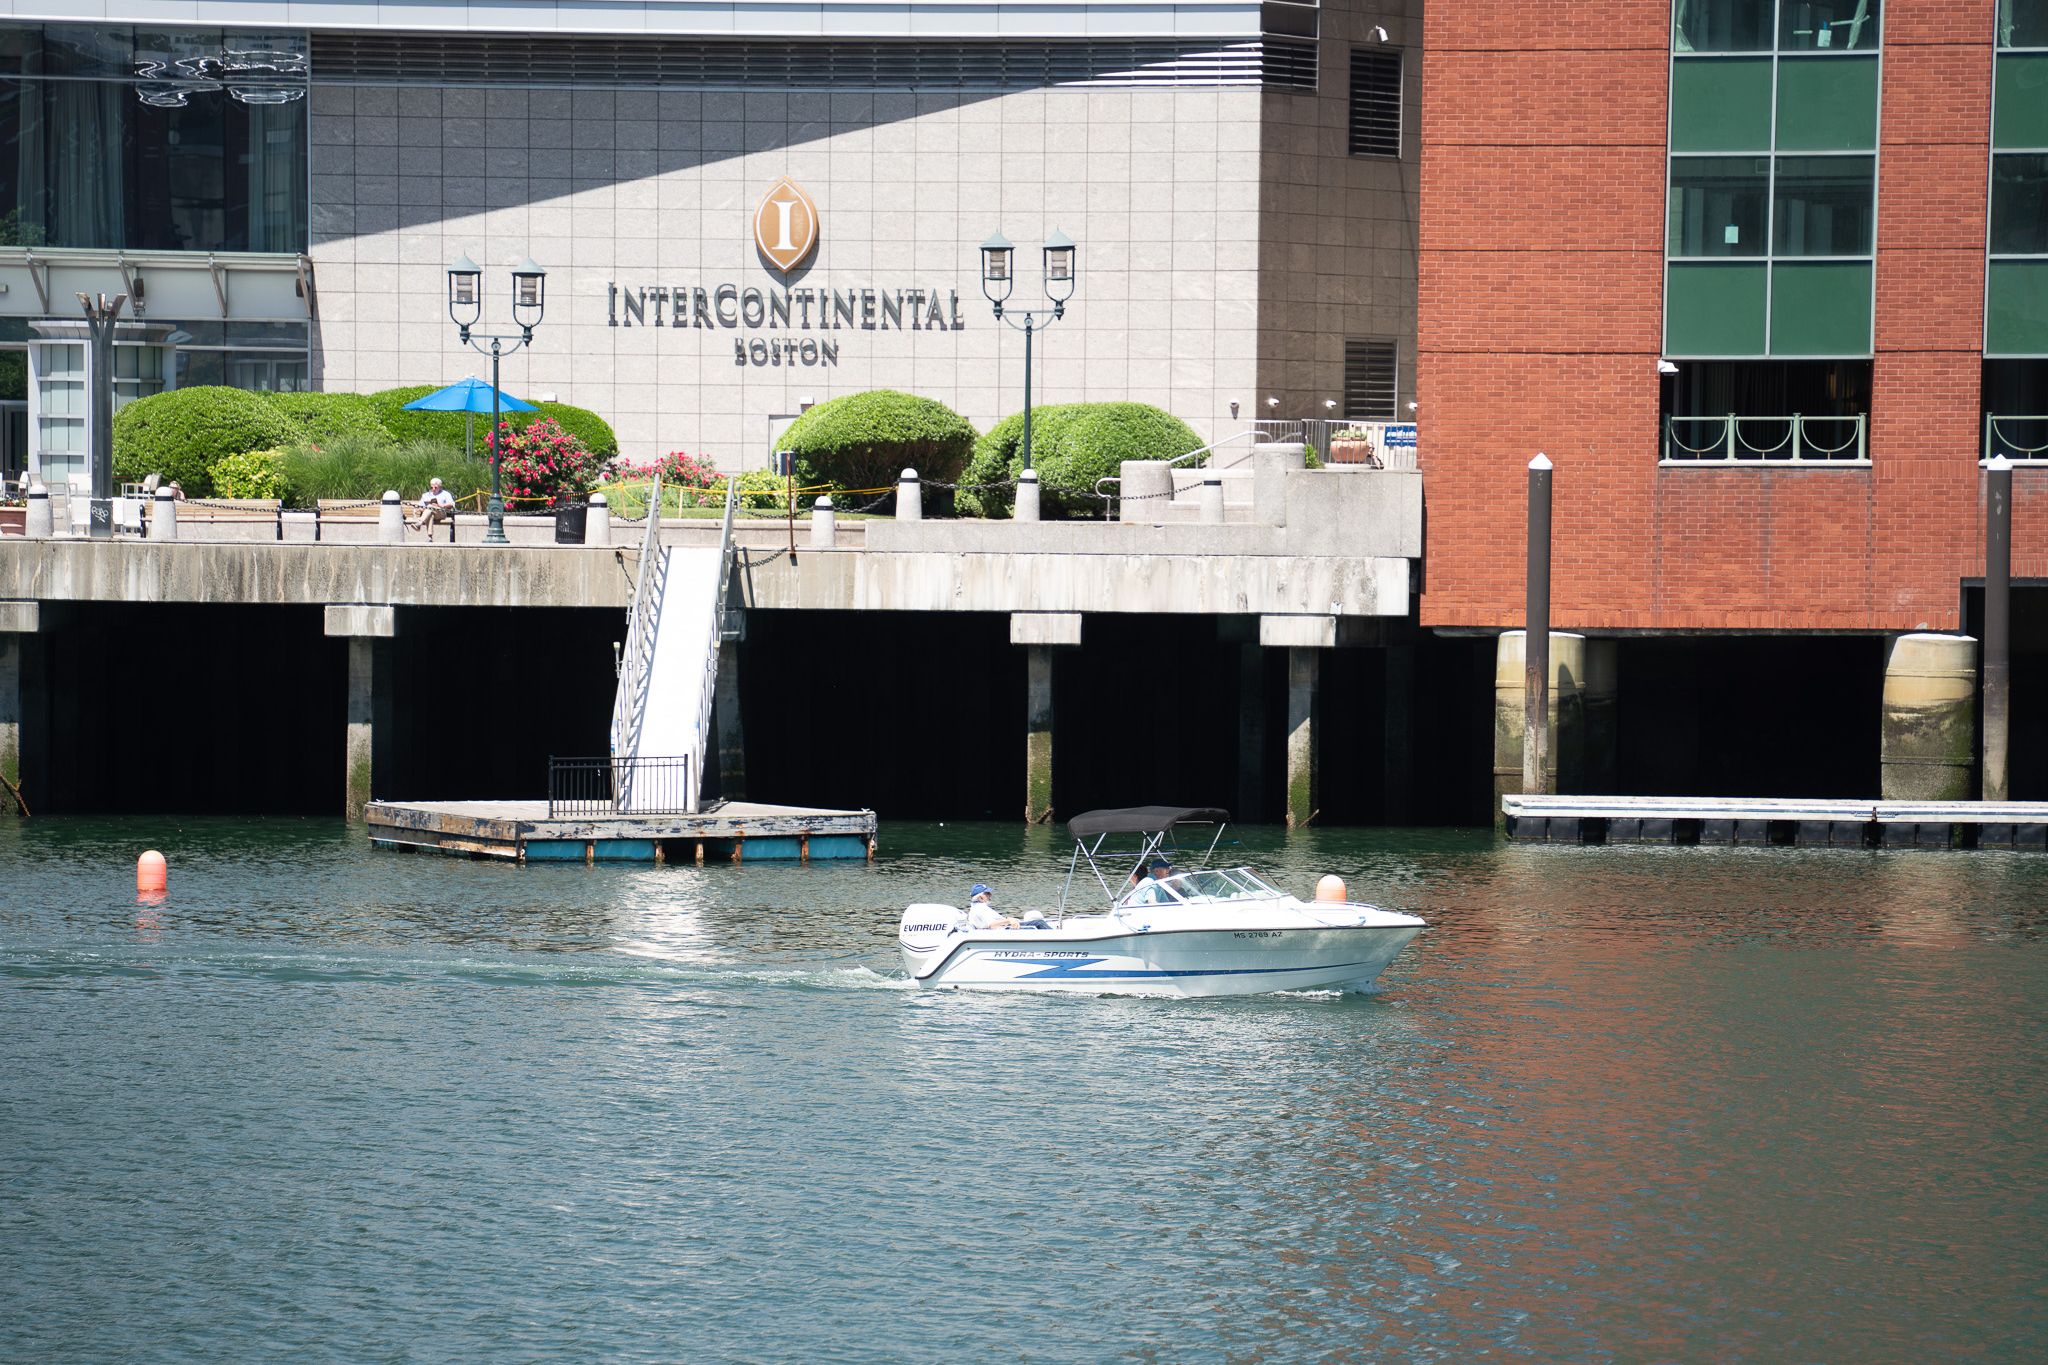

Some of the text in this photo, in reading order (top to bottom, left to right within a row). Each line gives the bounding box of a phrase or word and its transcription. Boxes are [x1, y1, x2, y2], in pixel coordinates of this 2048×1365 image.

[608, 282, 965, 329] INTERCONTINENTAL
[734, 337, 840, 365] BOSTON
[903, 923, 948, 932] EVINRUDE
